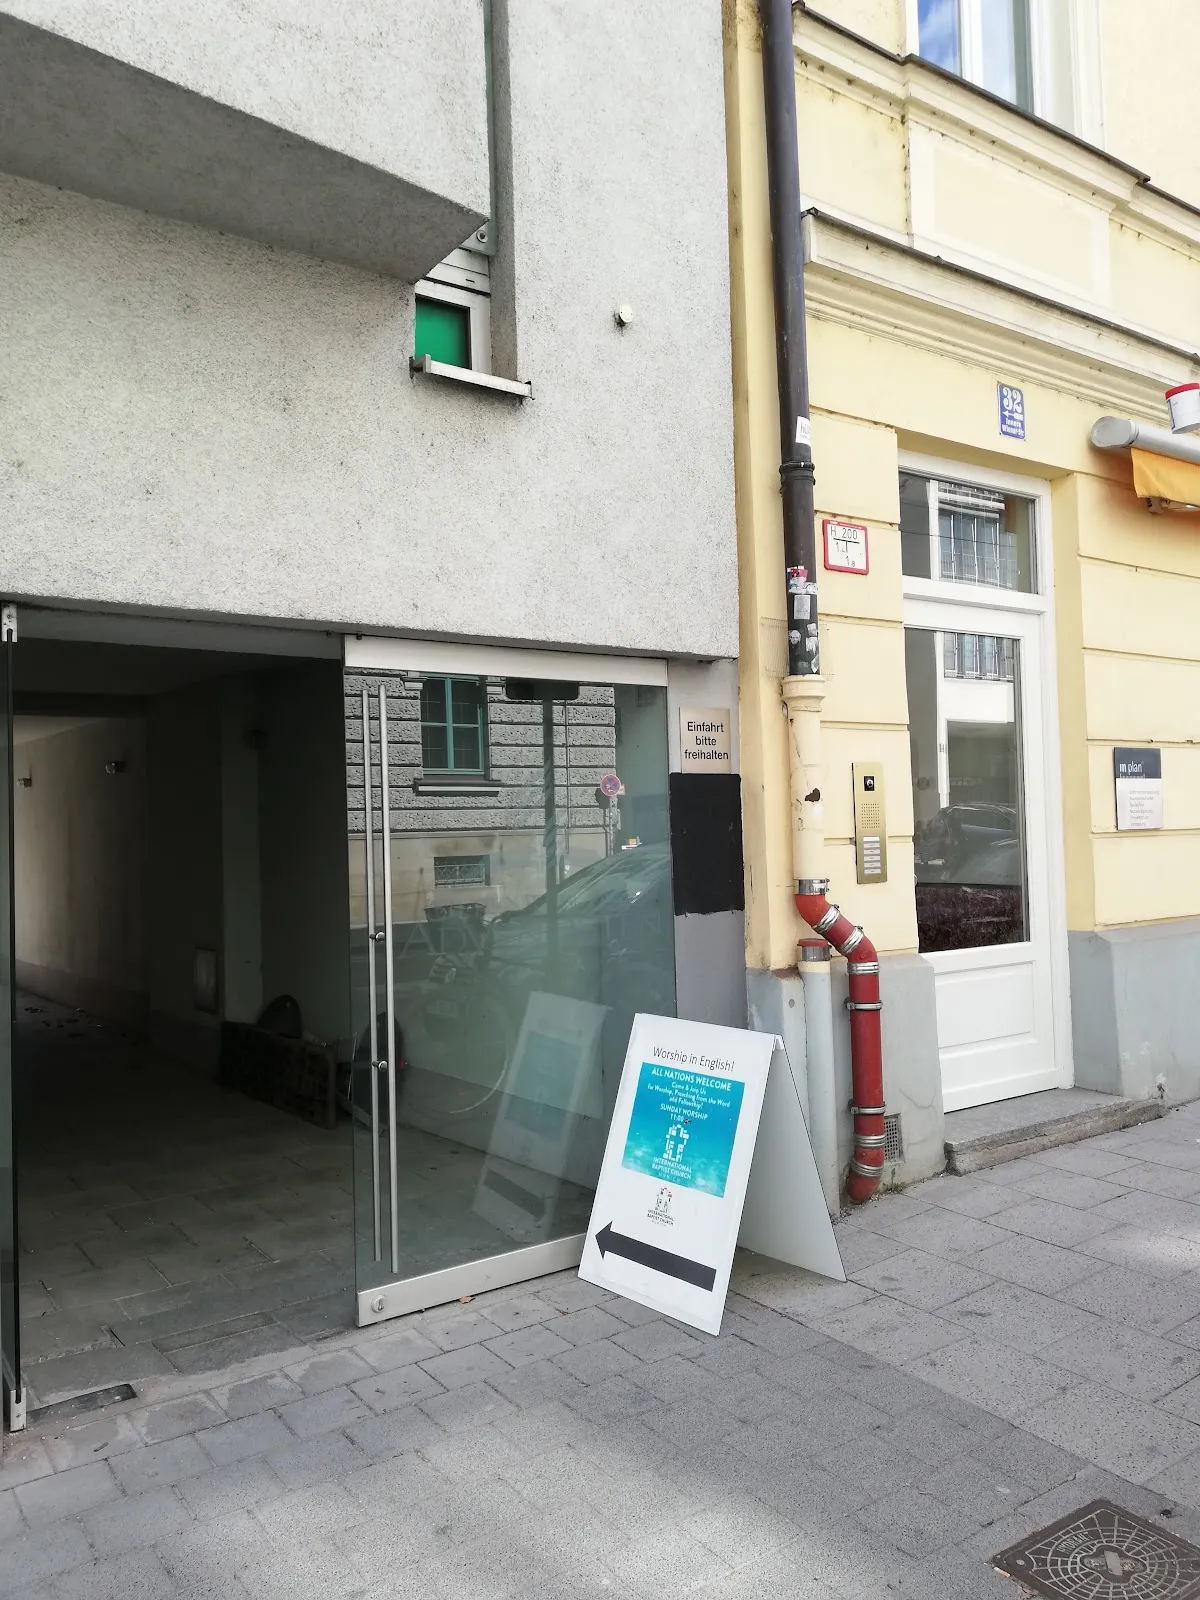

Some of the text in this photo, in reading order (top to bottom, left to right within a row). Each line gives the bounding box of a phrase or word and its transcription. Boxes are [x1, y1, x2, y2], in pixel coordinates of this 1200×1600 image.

[1003, 386, 1023, 414] 32
[830, 525, 837, 537] H
[842, 527, 858, 540] 200
[687, 721, 724, 733] Einfahrt
[695, 735, 717, 746] bitte
[684, 749, 729, 760] freihalten
[653, 1046, 735, 1072] Worship in English!
[651, 1067, 732, 1092] ALL NATIONS WELCOME
[671, 1081, 684, 1089] Come
[717, 1098, 731, 1108] Word
[660, 1103, 709, 1121] SUNDAY WORSHIP
[651, 1163, 692, 1180] BAPTIST CHURCH
[653, 1156, 692, 1174] INTERNATIONAL
[1056, 1531, 1095, 1555] HYDRANT
